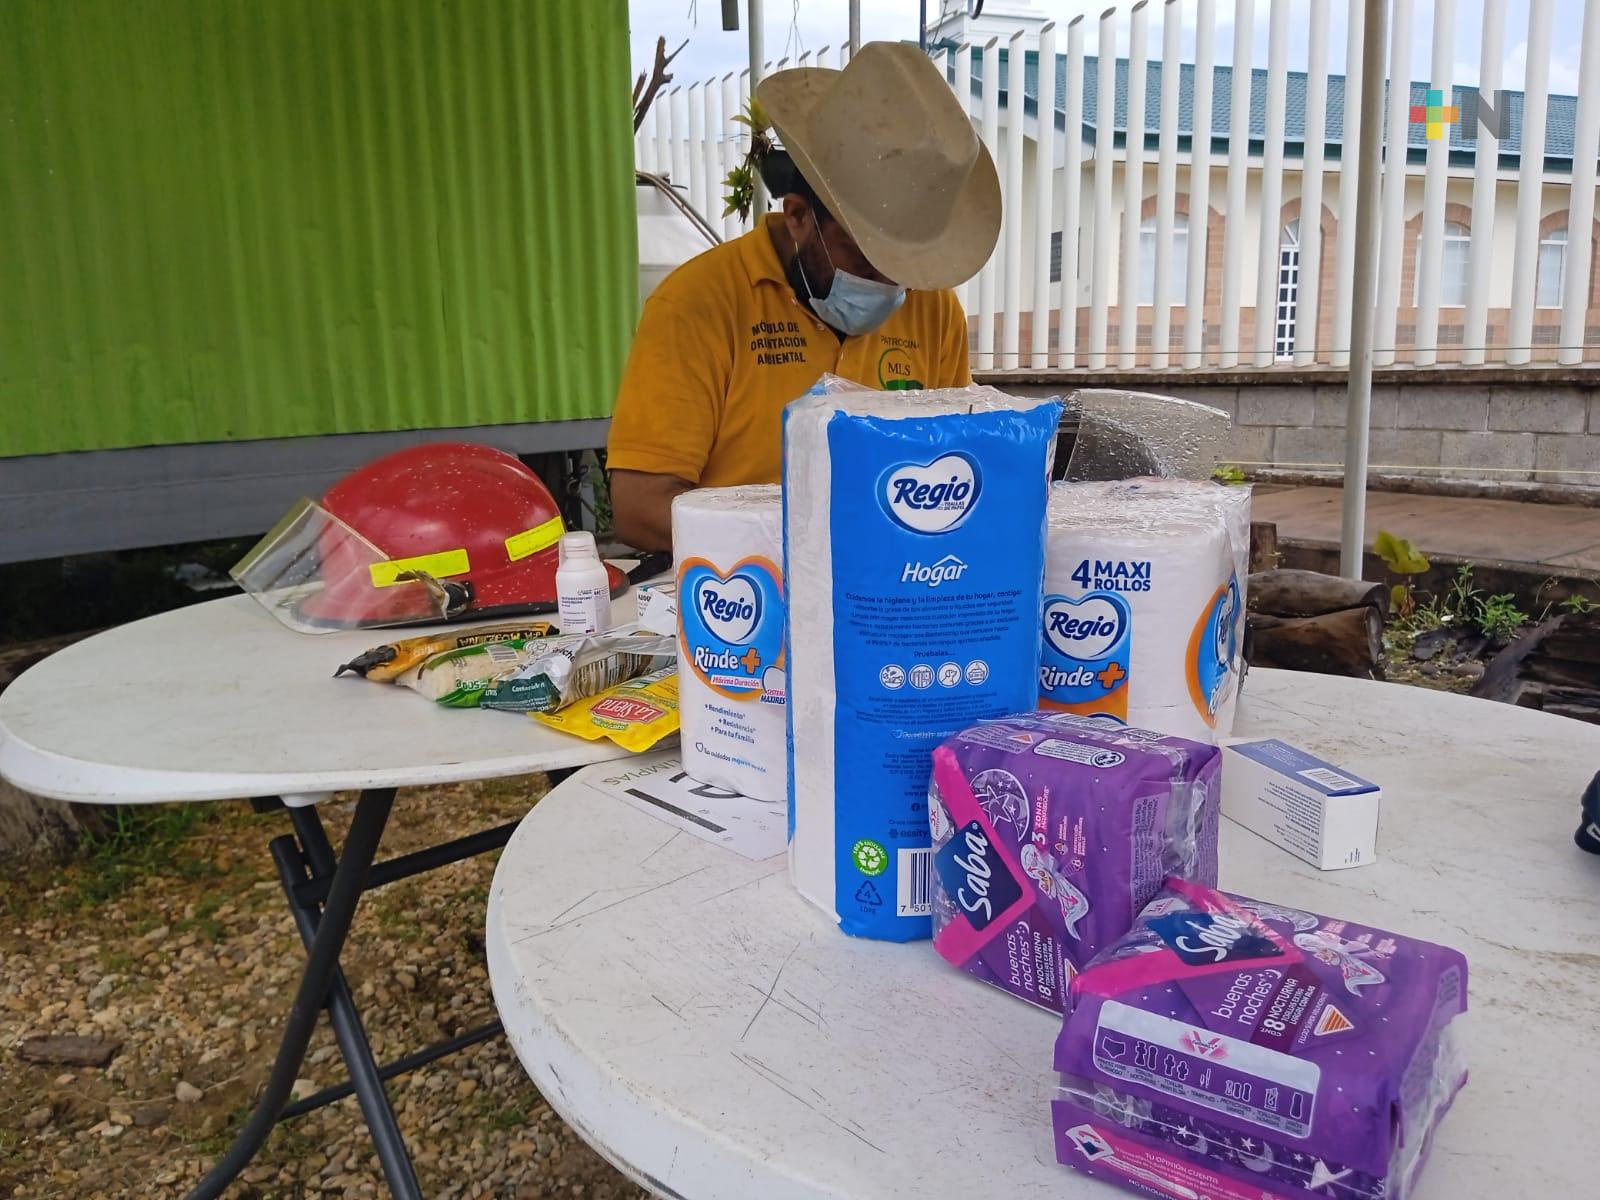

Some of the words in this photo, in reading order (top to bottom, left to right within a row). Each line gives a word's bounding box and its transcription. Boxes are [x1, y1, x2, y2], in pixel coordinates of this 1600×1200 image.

[787, 321, 800, 333] DE
[888, 361, 911, 376] MLS
[893, 475, 970, 510] Regio
[900, 557, 968, 588] Hogar
[1071, 559, 1091, 589] 4
[1094, 561, 1151, 579] MAXI
[1094, 579, 1151, 592] ROLLOS
[702, 589, 753, 622] Regio
[1049, 611, 1116, 641] Regio
[598, 698, 638, 719] Sierra
[637, 705, 658, 722] La
[1035, 796, 1043, 828] ZONAS
[1032, 831, 1046, 845] 3
[953, 829, 993, 922] Saba
[1175, 914, 1248, 962] Saba
[1006, 933, 1021, 987] buenas
[1018, 939, 1035, 993] noches
[1033, 931, 1045, 986] NOCTURNA
[1038, 984, 1053, 997] 8
[1211, 972, 1253, 1020] buenas
[1238, 979, 1273, 1026] noches
[1267, 978, 1299, 1019] NOCTURNA
[1263, 1018, 1286, 1031] 8
[1145, 1152, 1156, 1162] TU
